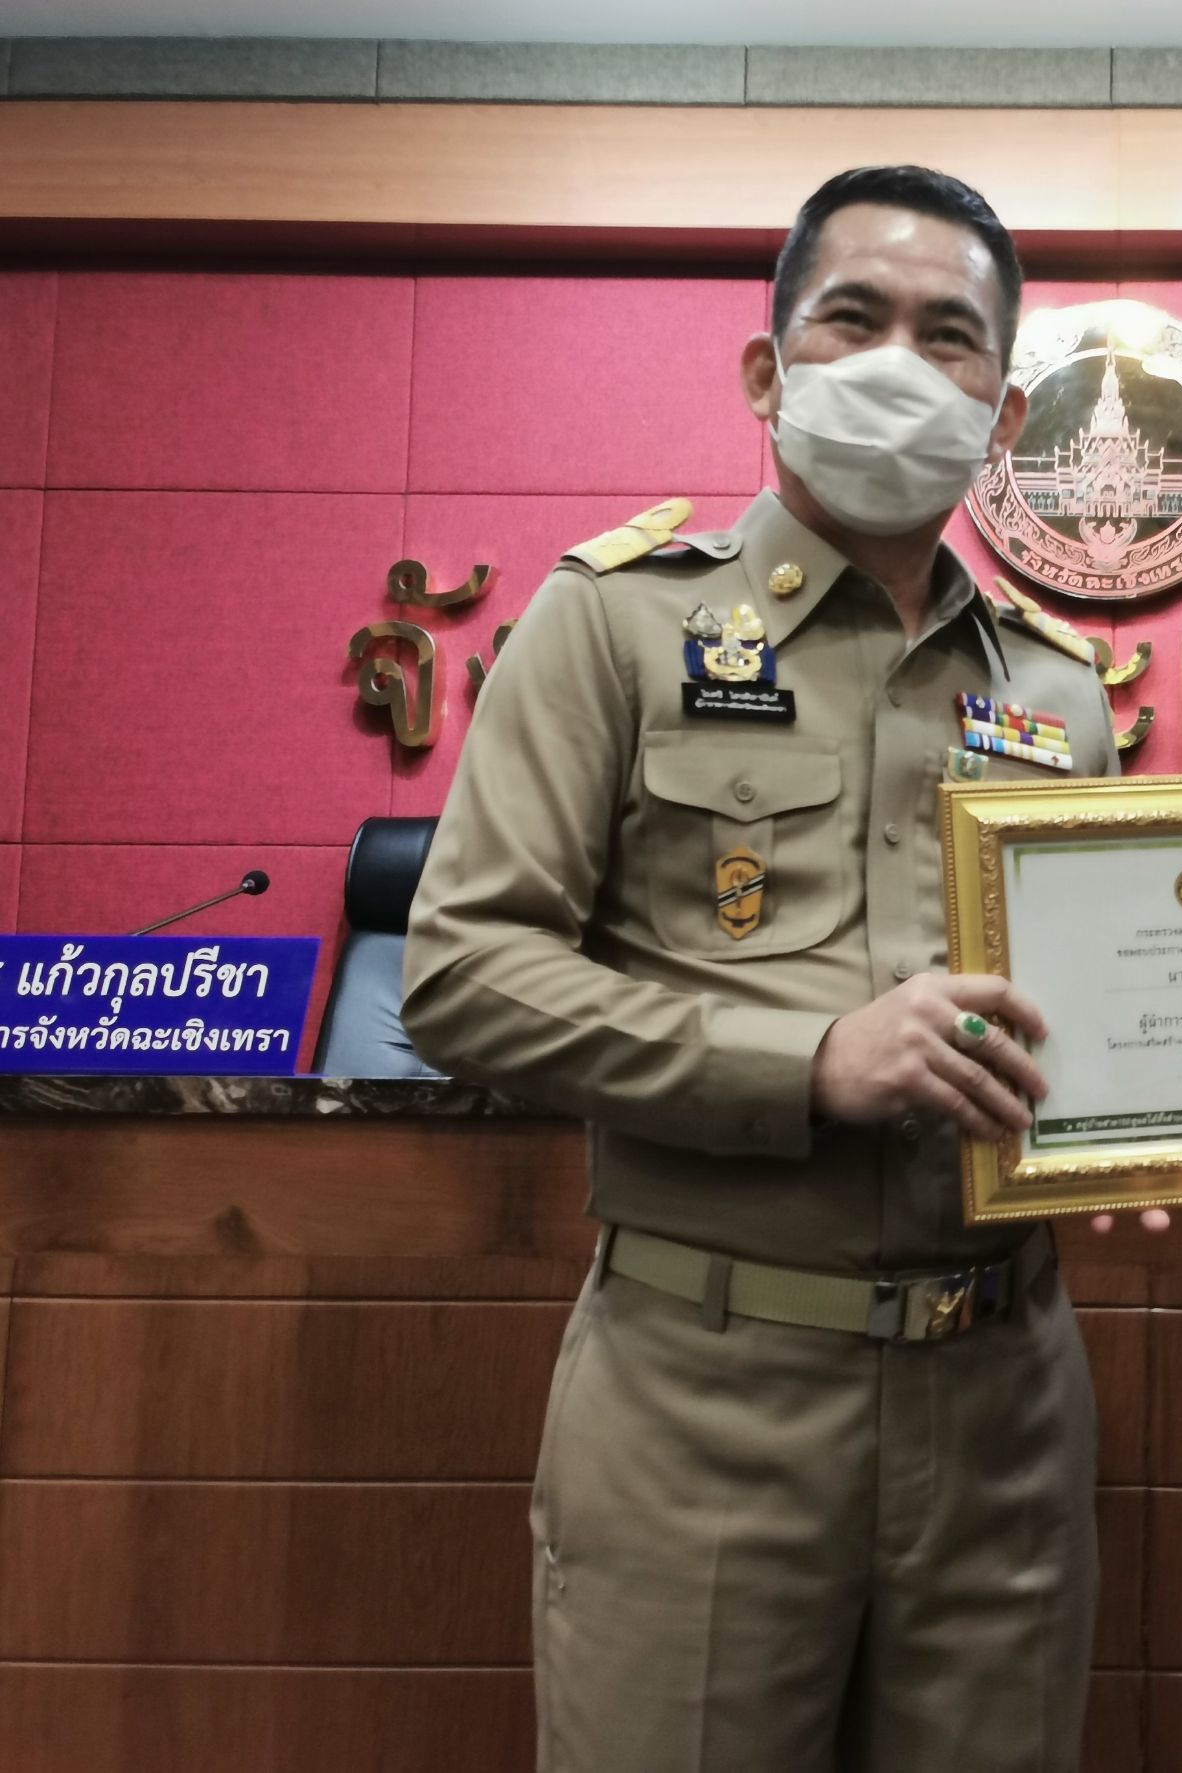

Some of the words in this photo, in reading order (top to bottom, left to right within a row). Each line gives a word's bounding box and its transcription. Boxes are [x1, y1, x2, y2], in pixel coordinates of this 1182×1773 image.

[16, 943, 269, 1014] แก้วกุลปรีชา
